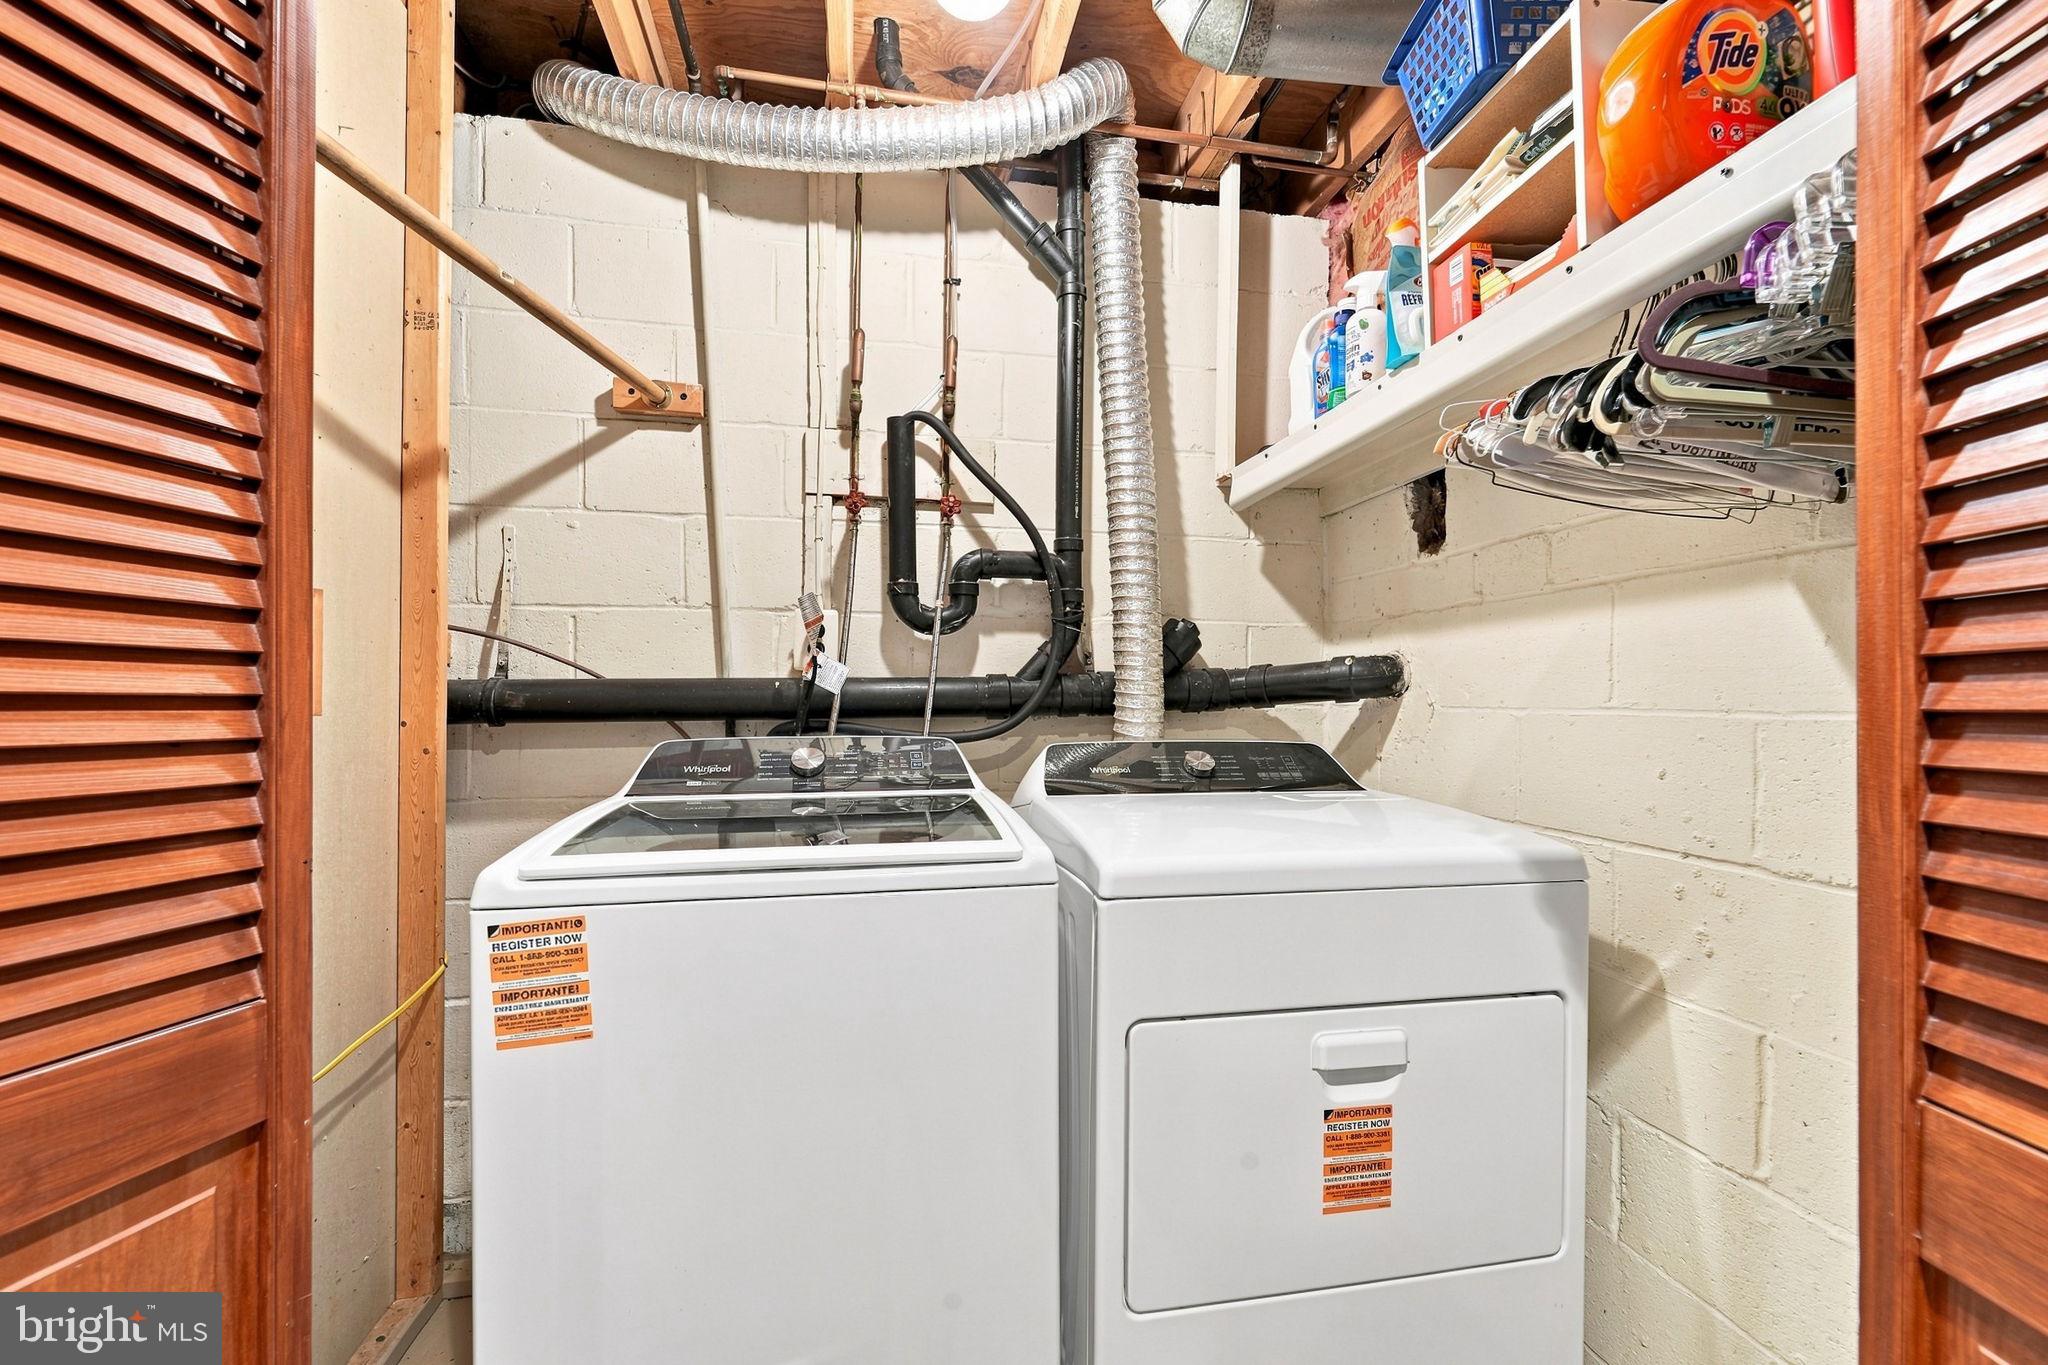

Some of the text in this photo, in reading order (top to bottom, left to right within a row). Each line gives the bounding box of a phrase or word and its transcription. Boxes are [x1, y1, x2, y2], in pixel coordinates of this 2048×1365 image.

[1708, 31, 1760, 75] Tide
[683, 764, 731, 776] Whirlpool
[1089, 765, 1131, 776] Whirlpool
[501, 920, 574, 936] IMPORTANT!
[492, 933, 583, 953] REGISTER NOW
[492, 955, 517, 965] CALL
[500, 984, 580, 1002] IMPORTANTE!
[1334, 1107, 1385, 1119] IMPORTANT!
[1326, 1119, 1391, 1132] REGISTER NOW
[1329, 1161, 1386, 1175] IMPORTANTE!
